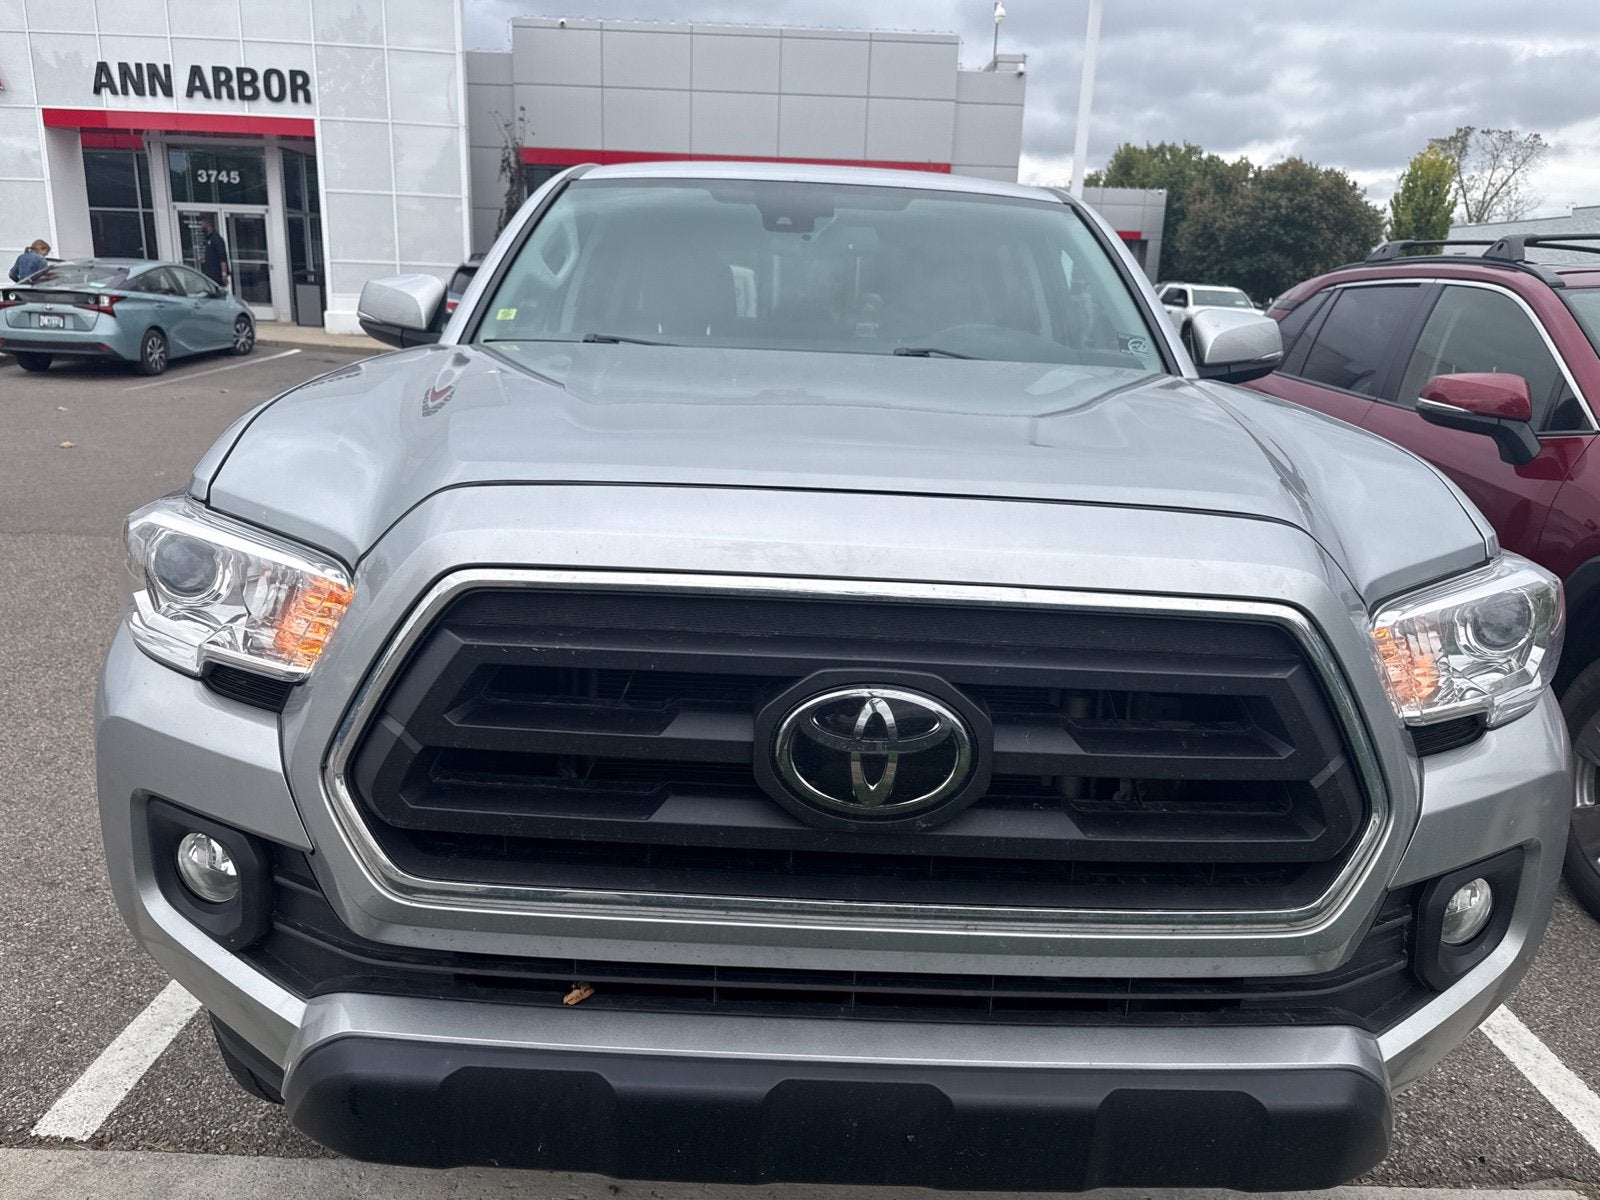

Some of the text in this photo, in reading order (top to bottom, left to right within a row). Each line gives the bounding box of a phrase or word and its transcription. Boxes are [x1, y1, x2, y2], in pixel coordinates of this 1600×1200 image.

[93, 61, 312, 104] ANN ARBOR
[197, 169, 241, 184] 3745
